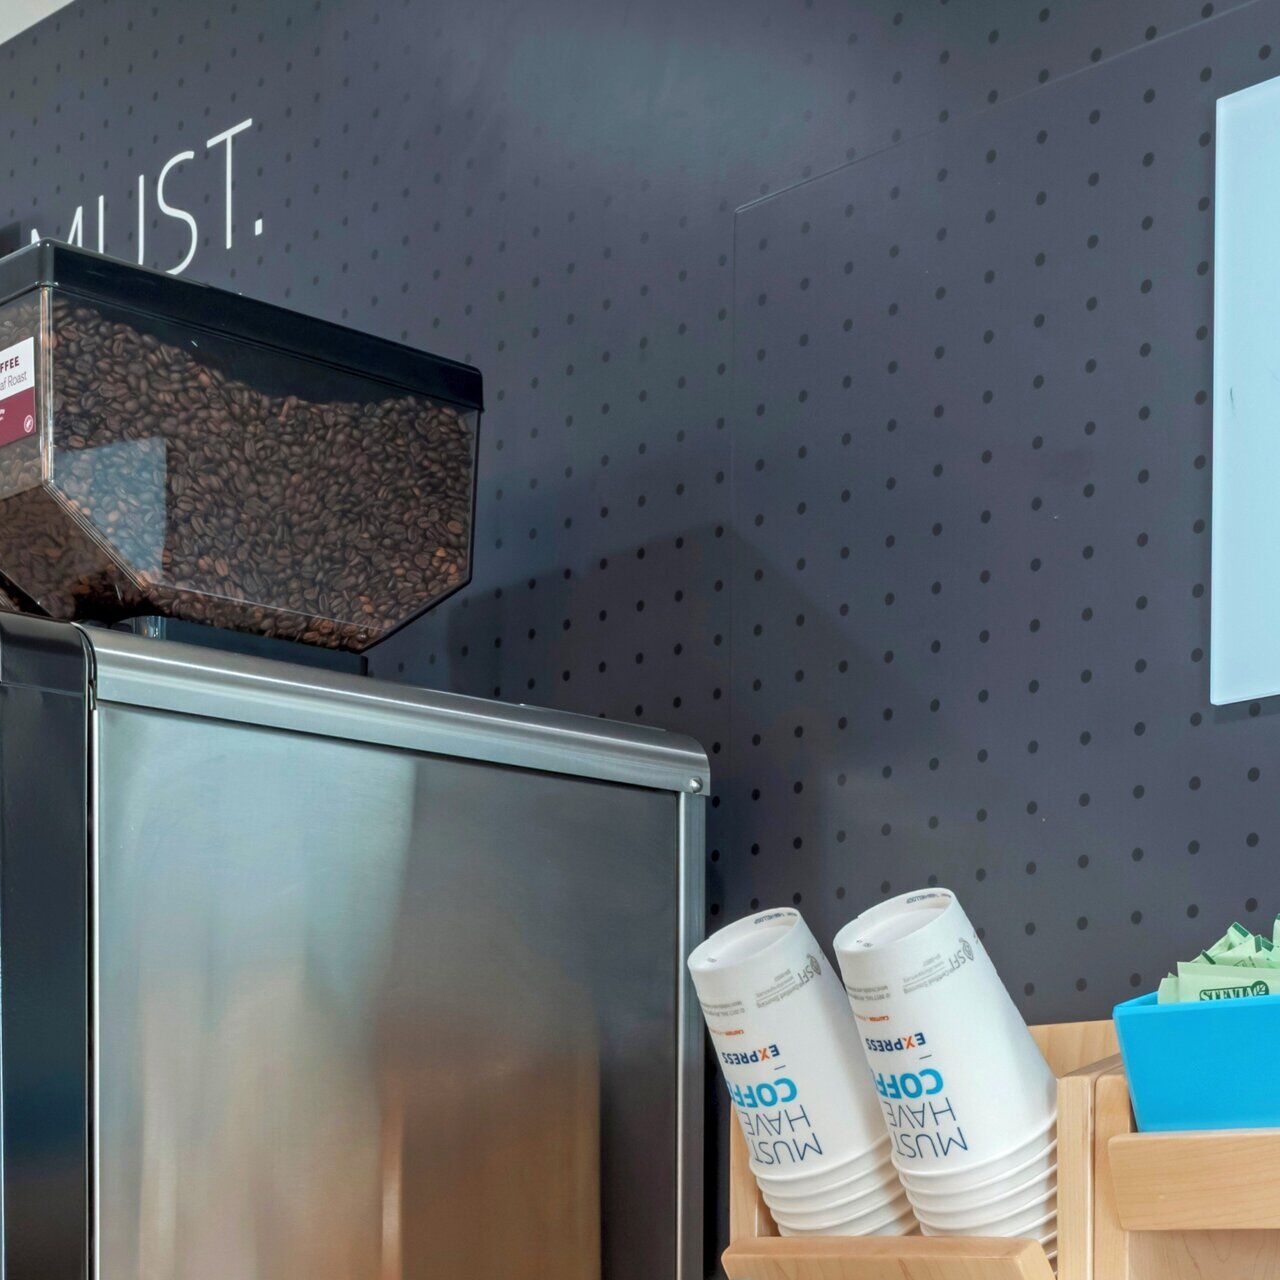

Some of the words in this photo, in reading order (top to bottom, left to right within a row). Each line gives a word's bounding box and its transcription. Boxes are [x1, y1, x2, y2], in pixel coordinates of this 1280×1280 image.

[8, 371, 28, 388] Roast
[948, 950, 966, 971] SFI
[797, 964, 814, 987] SFI
[1201, 985, 1253, 1000] STEVIA
[865, 1032, 926, 1052] EXPRESS
[722, 1044, 780, 1065] EXPRESS
[742, 1104, 811, 1136] HAVE
[884, 1097, 957, 1129] HAVE
[754, 1133, 823, 1165] MUST
[892, 1127, 968, 1159] MUST
